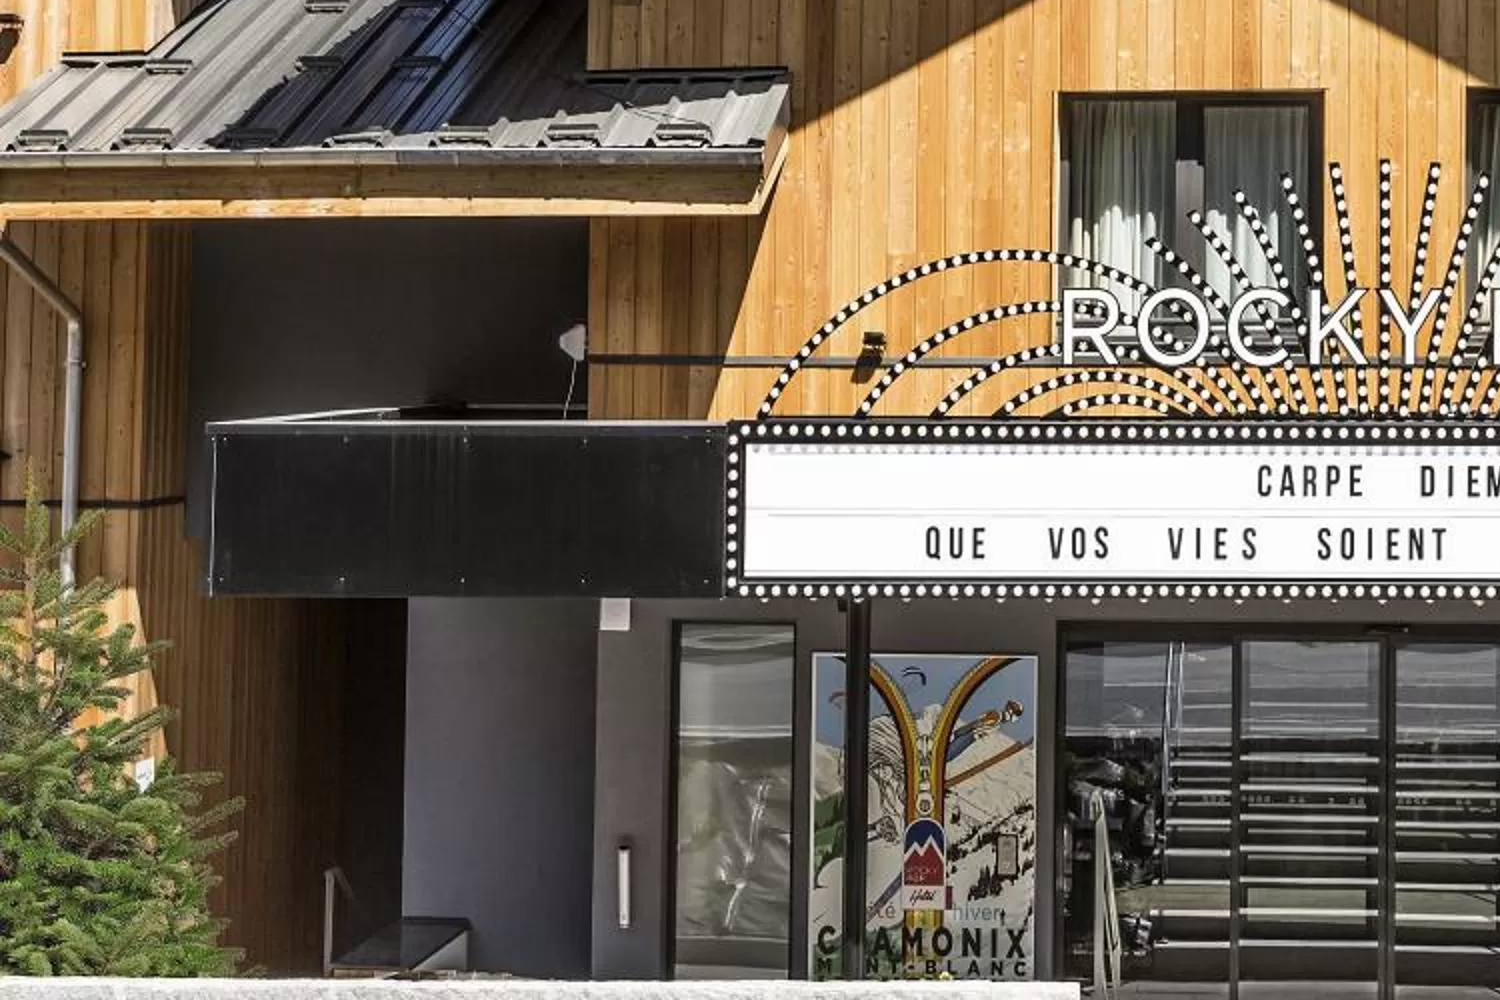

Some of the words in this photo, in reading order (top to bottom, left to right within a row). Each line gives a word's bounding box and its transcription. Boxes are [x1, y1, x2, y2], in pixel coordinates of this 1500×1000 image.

[1062, 287, 1443, 367] ROCKY
[1257, 464, 1364, 498] CARPE
[924, 526, 987, 561] QUE
[1047, 526, 1110, 561] VOS
[1167, 527, 1258, 561] VIES
[1316, 527, 1448, 562] SOIENT
[817, 925, 1026, 959] CAMONIX
[817, 957, 1028, 977] MNT-BLANC
